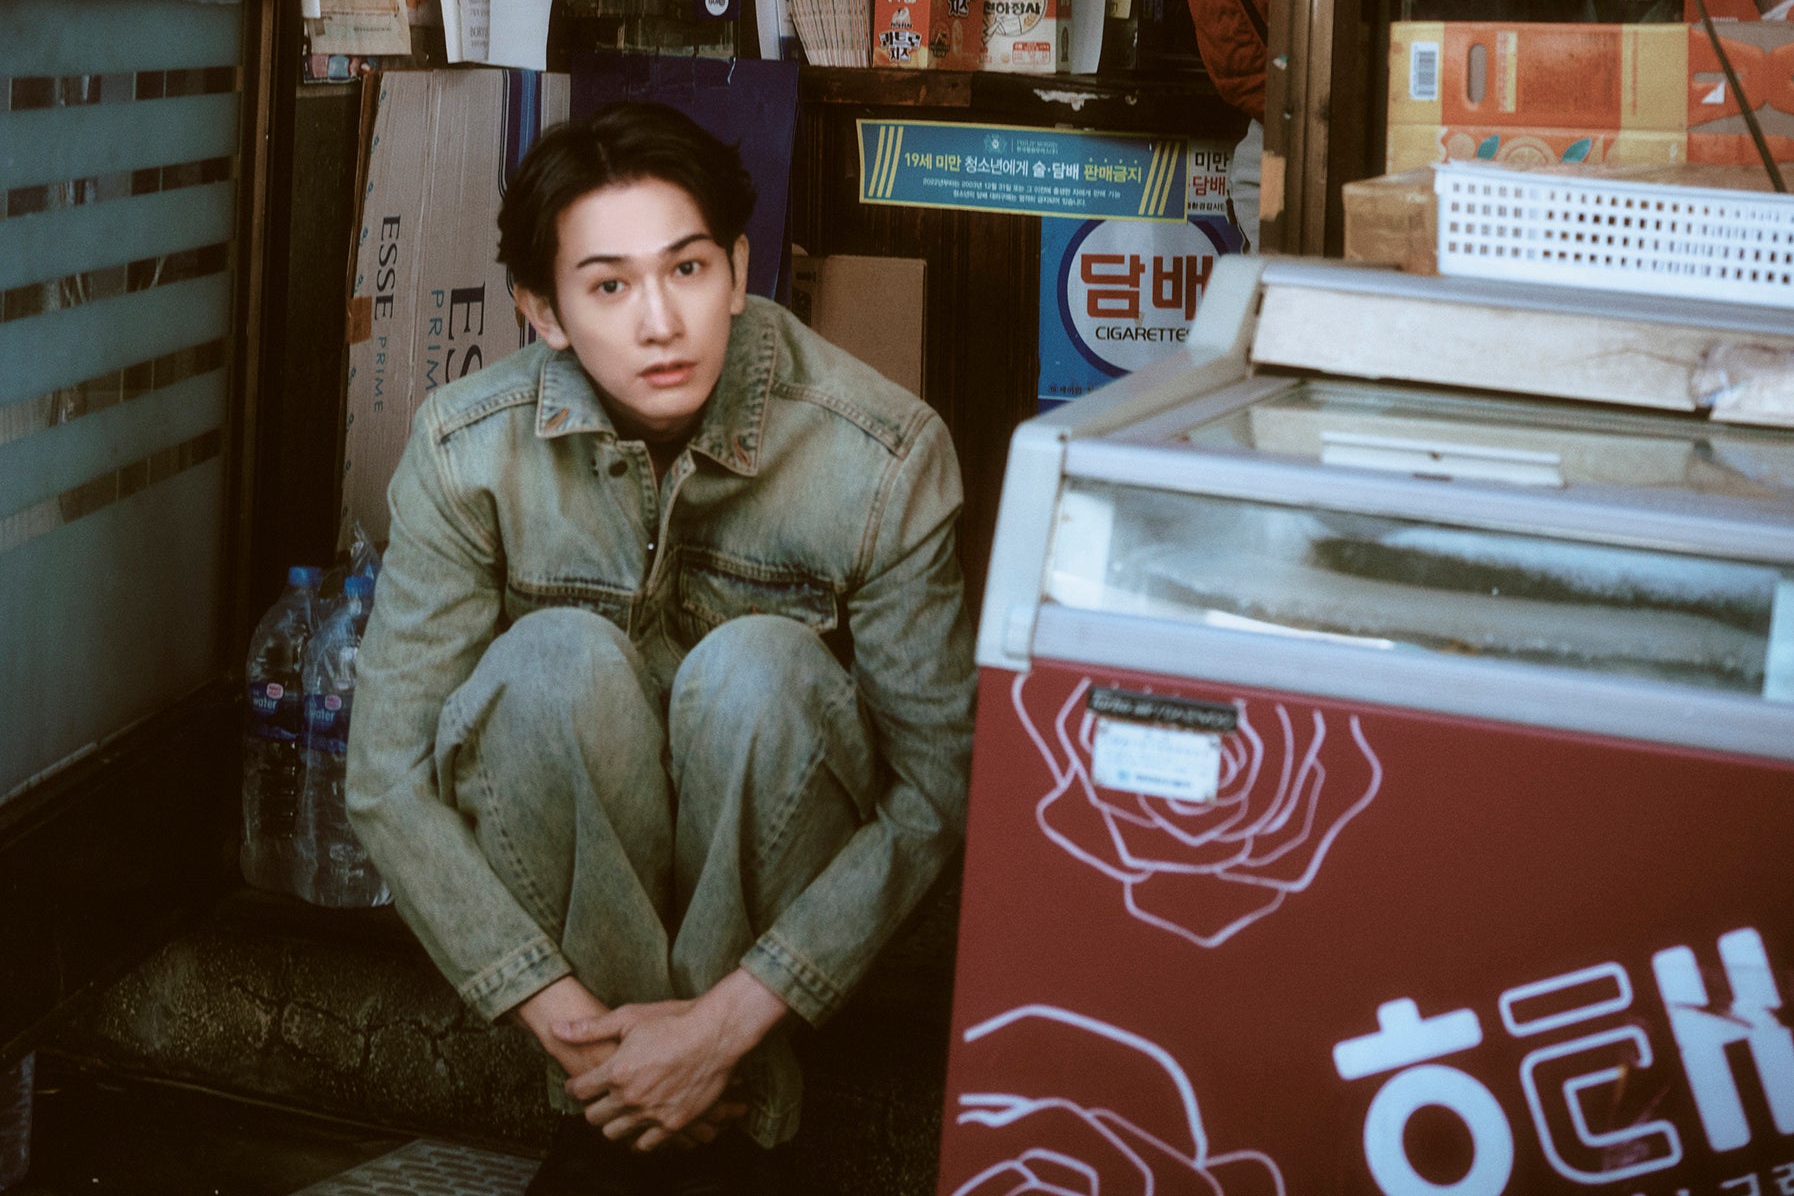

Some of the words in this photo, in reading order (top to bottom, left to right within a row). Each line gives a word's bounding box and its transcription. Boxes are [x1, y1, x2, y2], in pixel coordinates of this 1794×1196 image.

[904, 152, 932, 170] 19세
[936, 153, 961, 172] 미만
[964, 155, 1029, 178] 청소년에게
[1084, 163, 1142, 184] 판매금지
[1193, 174, 1226, 197] 담배
[1194, 151, 1229, 173] 미만
[374, 215, 401, 321] ESSE
[1080, 253, 1214, 321] 담배
[425, 289, 445, 391] PRIM
[445, 281, 486, 384] ES
[1095, 325, 1190, 342] CIGARETTE
[373, 336, 387, 413] PRIME
